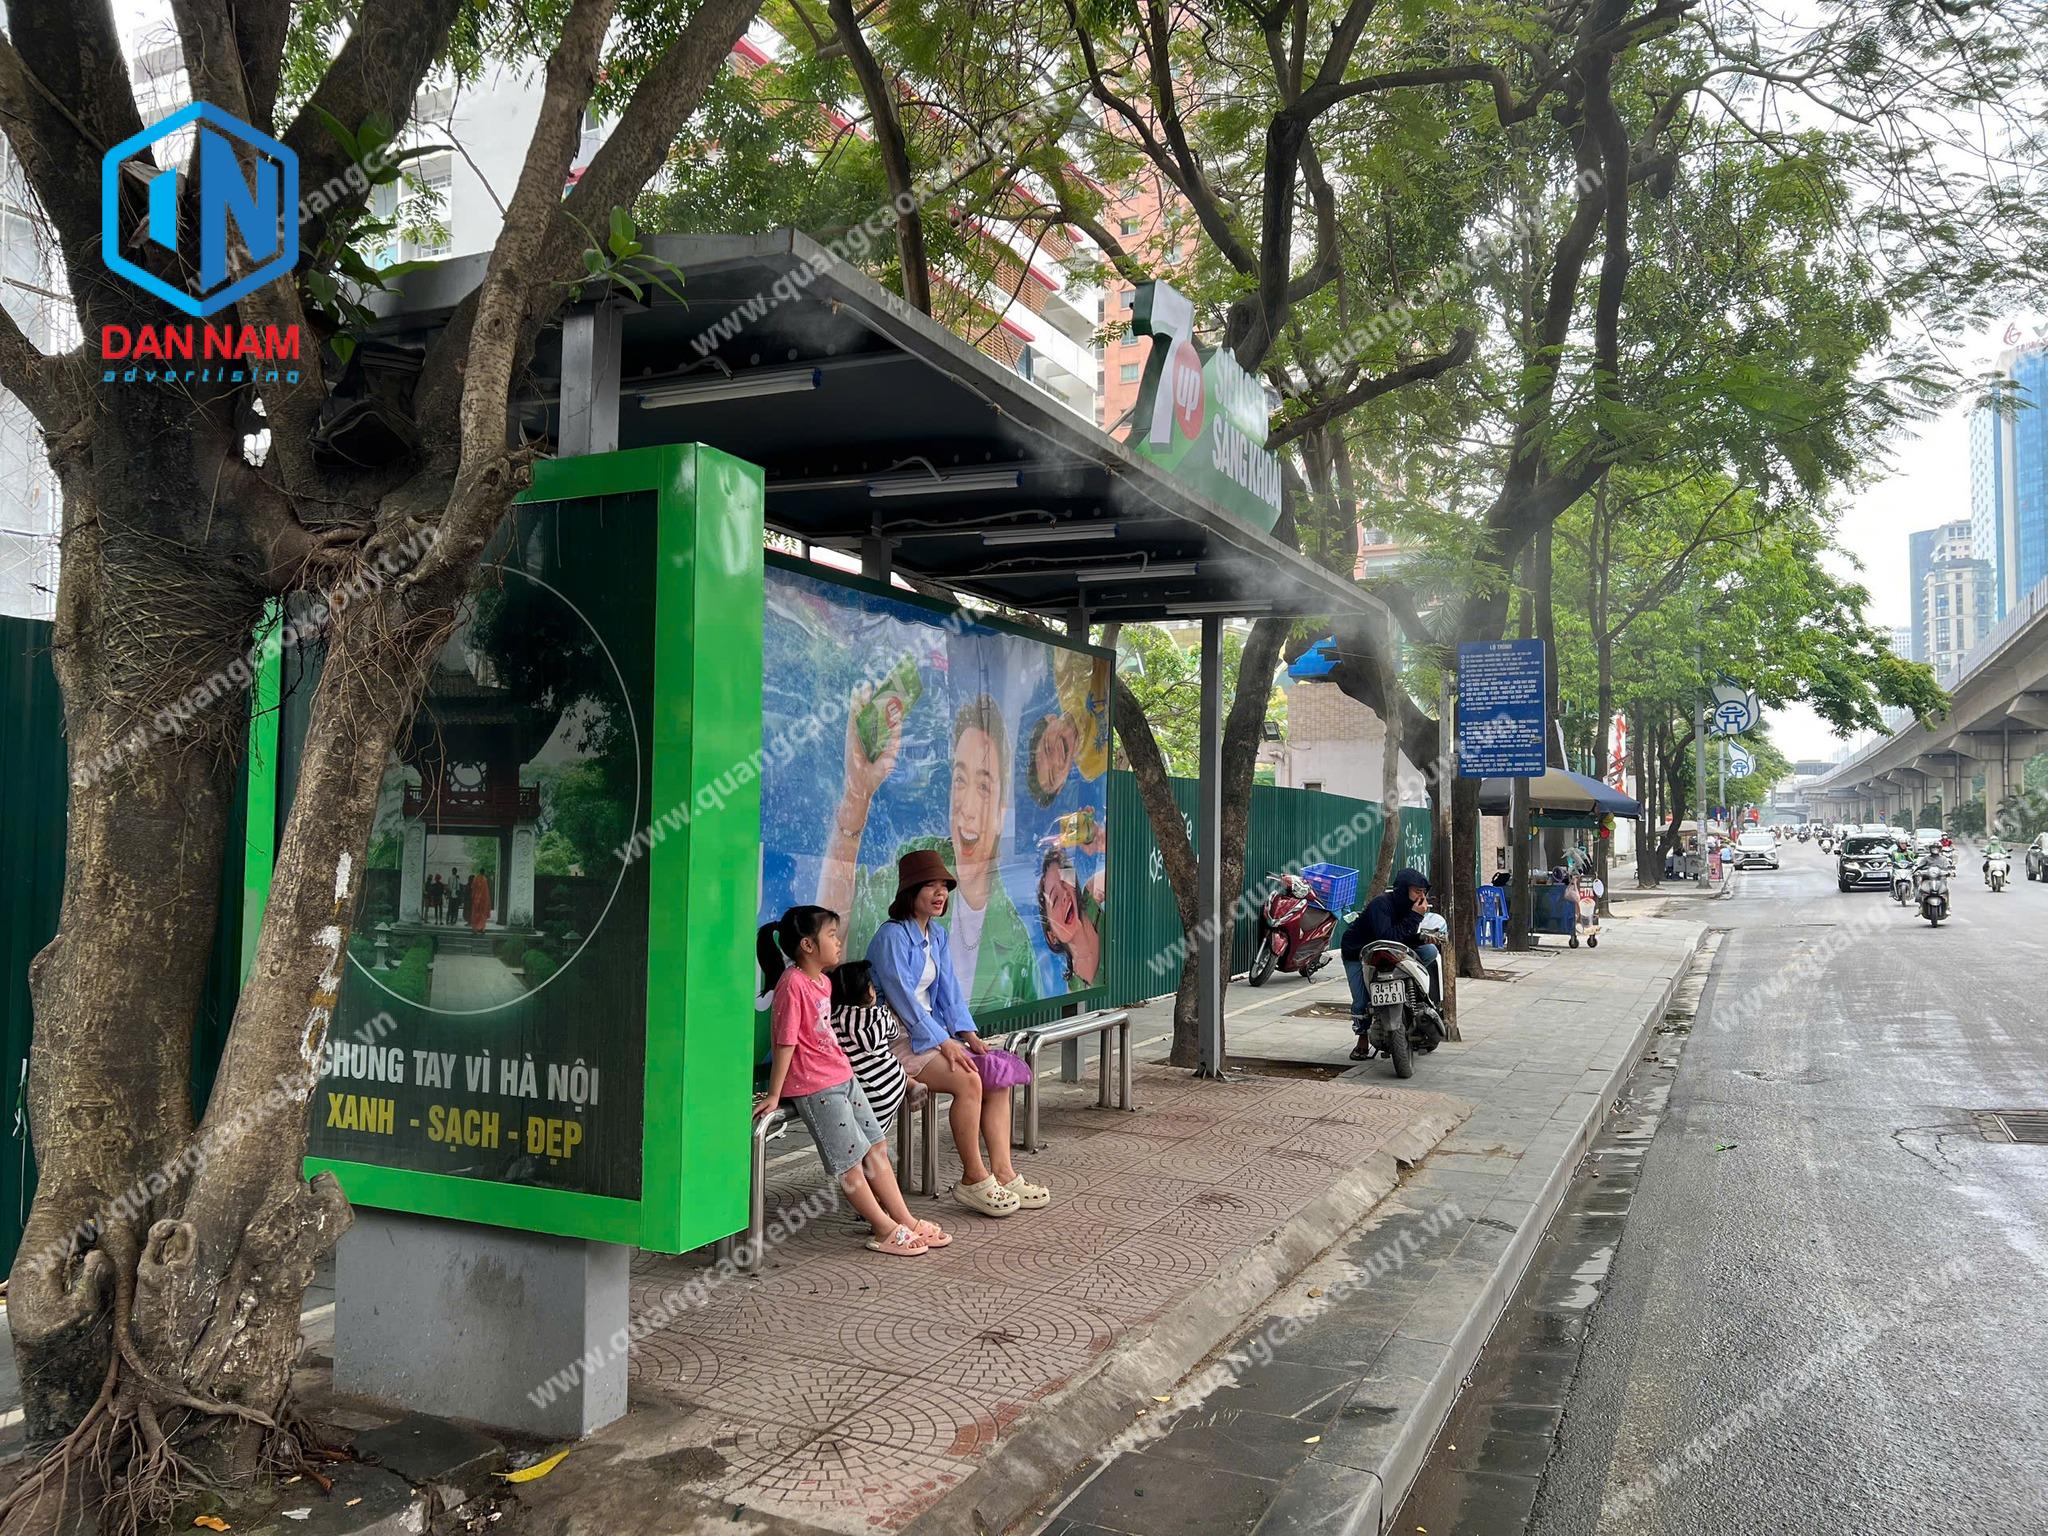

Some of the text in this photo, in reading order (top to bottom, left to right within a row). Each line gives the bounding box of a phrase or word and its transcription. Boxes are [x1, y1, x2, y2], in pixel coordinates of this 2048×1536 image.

[319, 1041, 599, 1112] CHUNG TAY VÌ HÀ NỘI
[327, 1093, 395, 1135] XANH
[428, 1105, 499, 1152] SẠCH
[527, 1117, 582, 1165] ĐẸP
